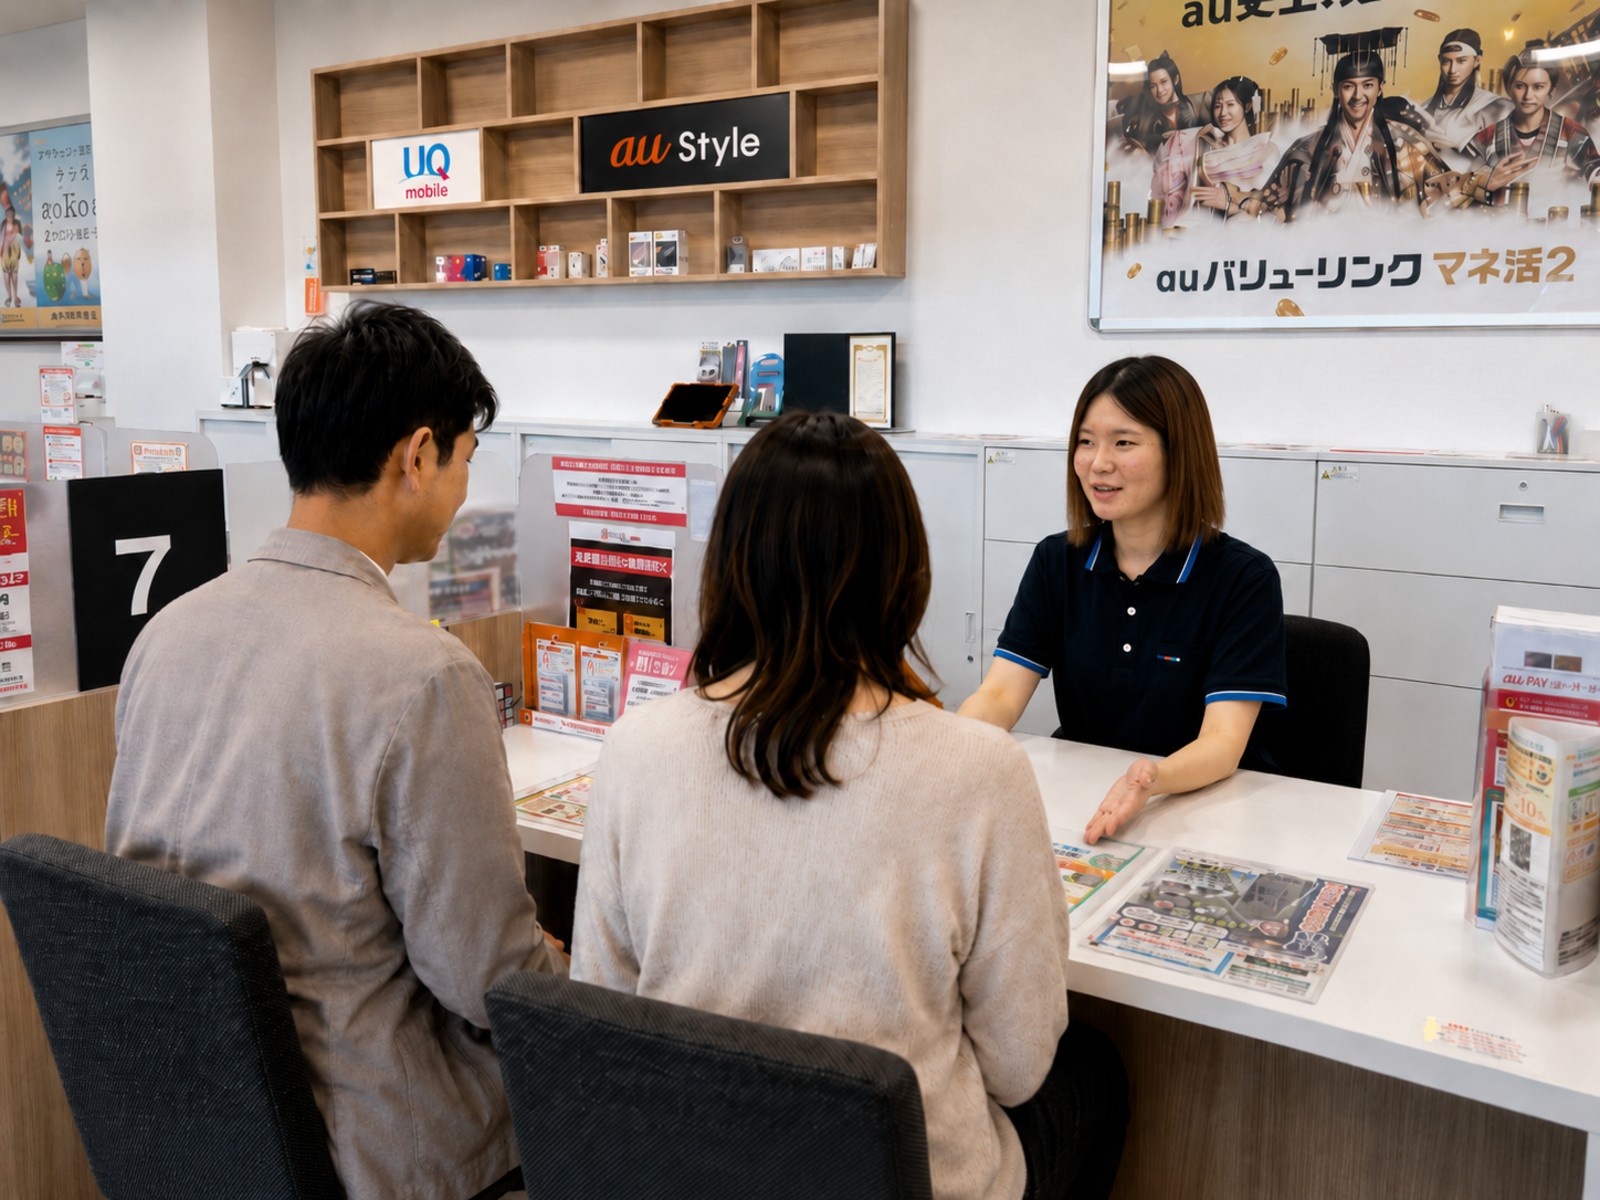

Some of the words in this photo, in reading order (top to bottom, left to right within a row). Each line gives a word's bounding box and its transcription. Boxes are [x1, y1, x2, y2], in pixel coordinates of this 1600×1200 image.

[403, 143, 451, 181] UQ
[610, 133, 672, 168] au
[678, 126, 760, 167] Style
[405, 182, 448, 199] mobile
[1156, 253, 1422, 293] auバリューリンク
[1433, 245, 1576, 285] マネ活2
[115, 534, 172, 616] 7
[1502, 674, 1525, 686] au
[1526, 676, 1549, 689] PAY
